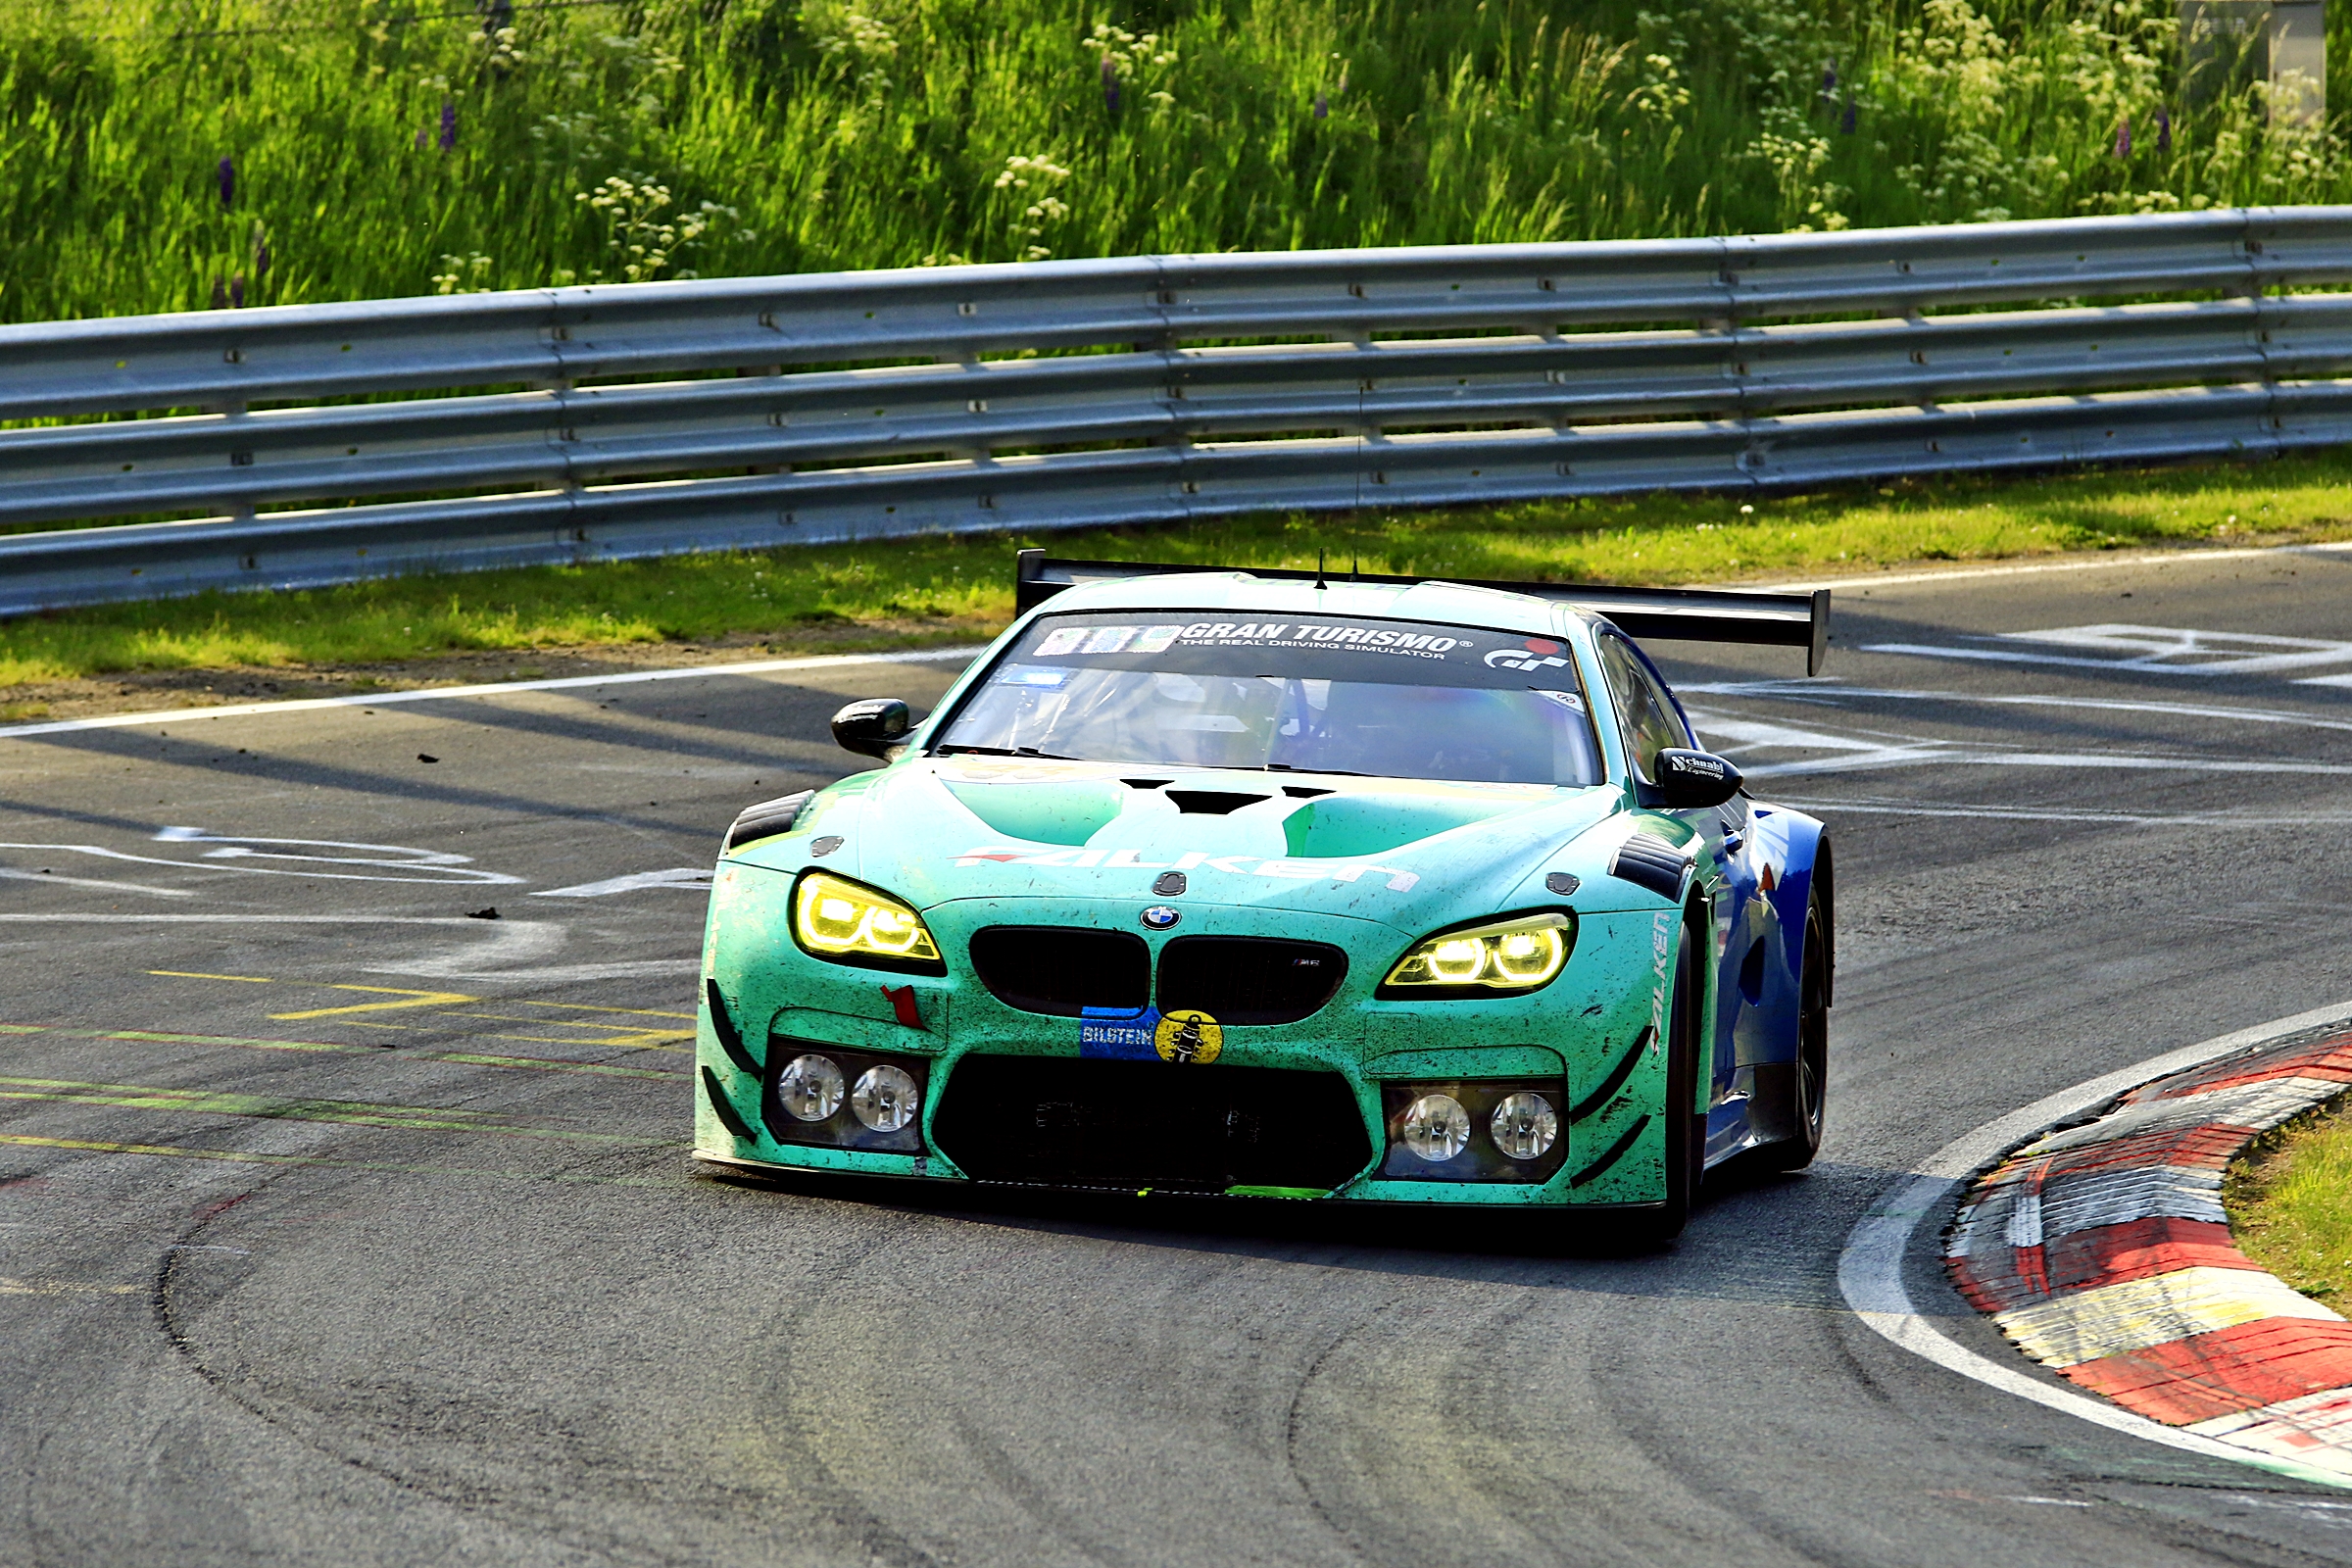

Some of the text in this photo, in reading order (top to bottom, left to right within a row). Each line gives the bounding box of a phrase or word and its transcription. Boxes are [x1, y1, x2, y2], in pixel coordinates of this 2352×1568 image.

[1181, 622, 1289, 639] GRAN
[1268, 640, 1340, 649] DRIVING
[1344, 643, 1446, 661] SIMULATOR
[1671, 756, 1724, 772] Schnabl
[1687, 765, 1724, 780] Engineering
[1082, 1026, 1152, 1046] BILSTEIN
